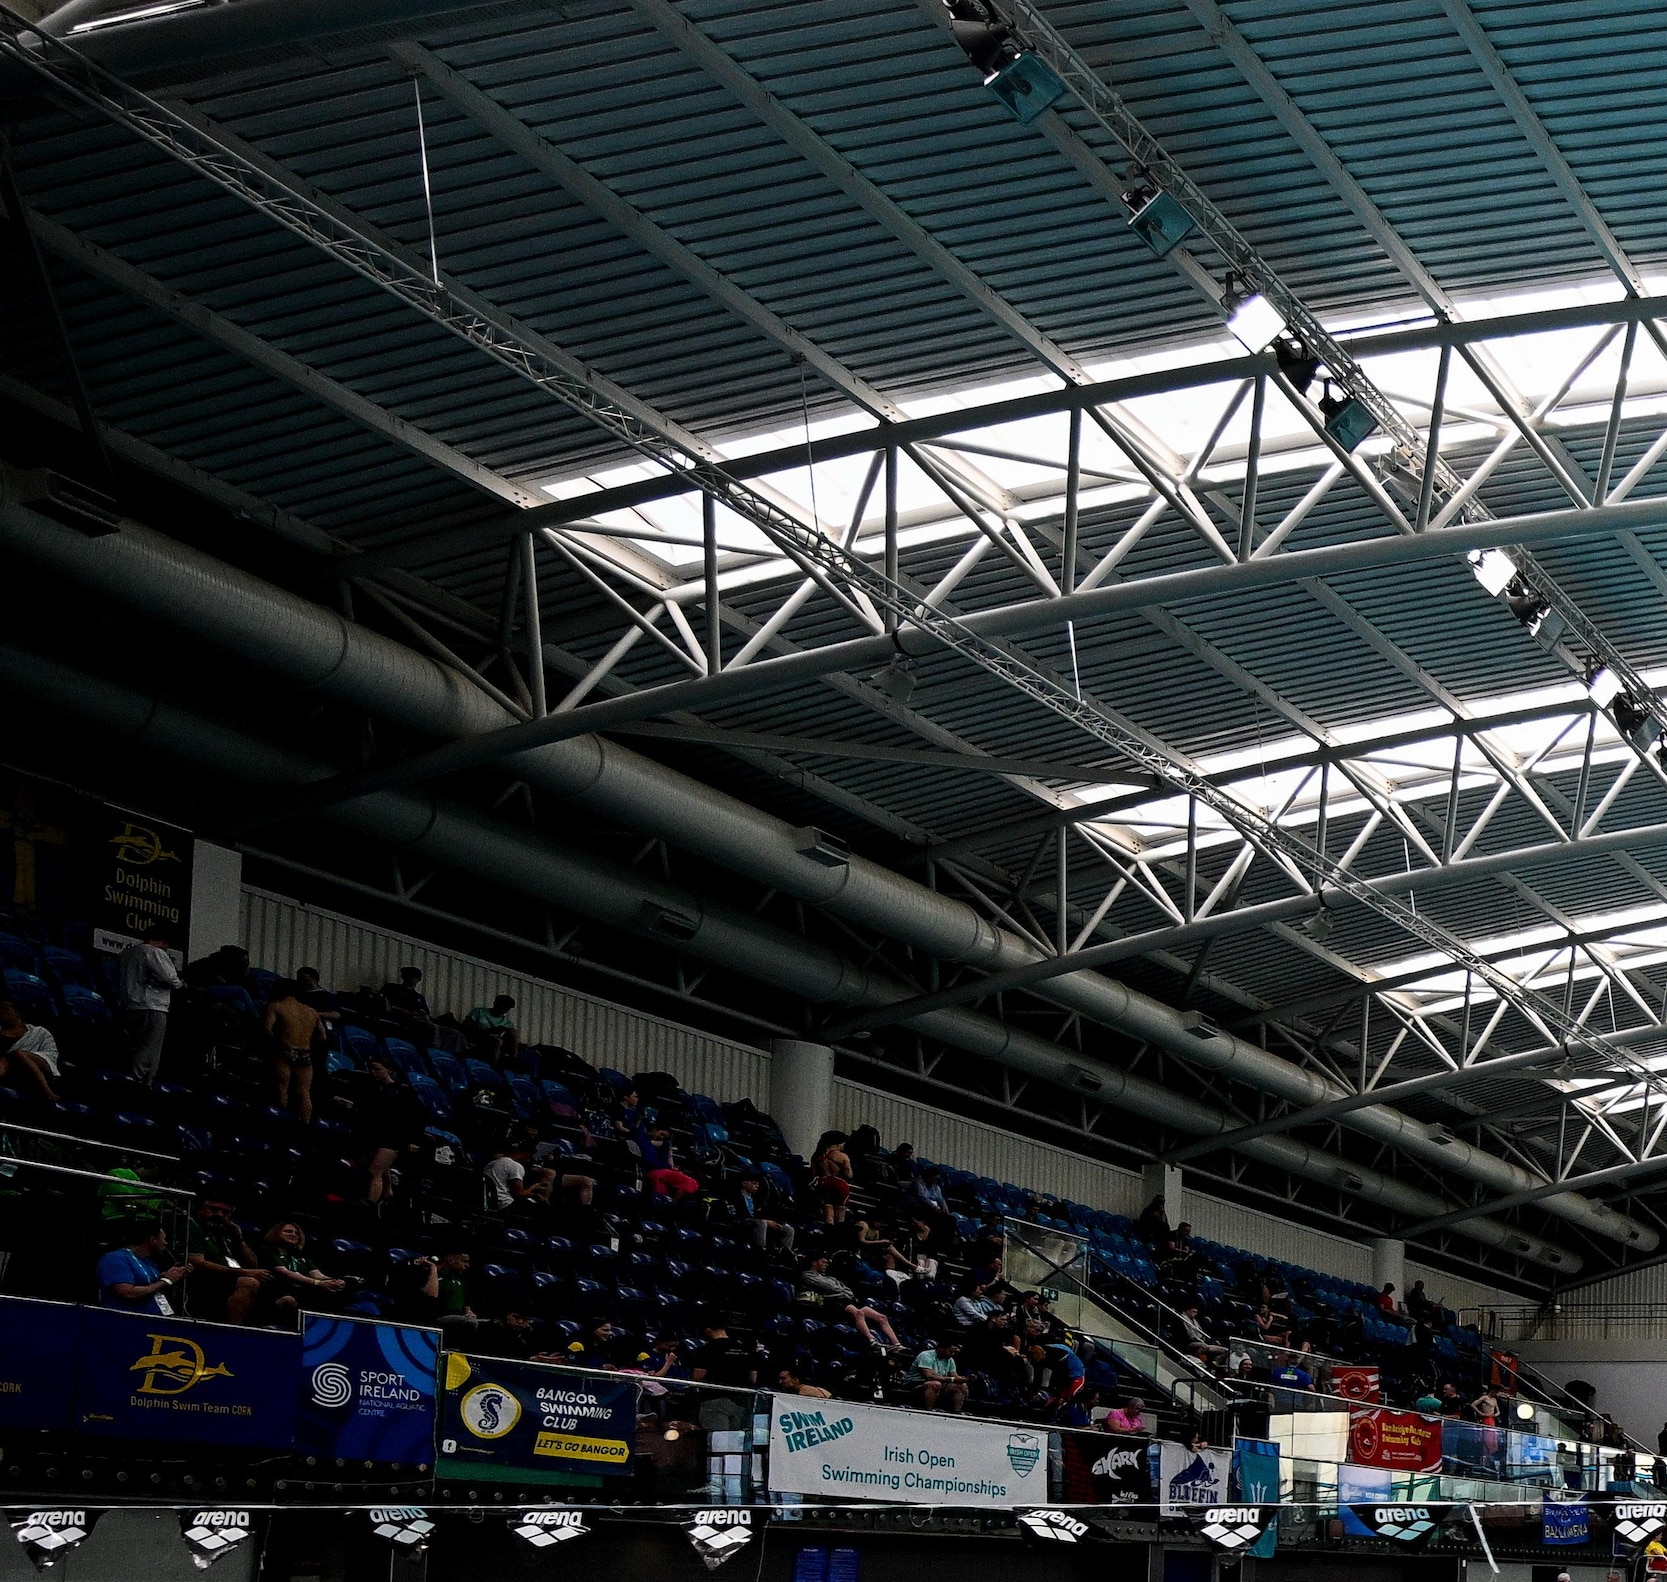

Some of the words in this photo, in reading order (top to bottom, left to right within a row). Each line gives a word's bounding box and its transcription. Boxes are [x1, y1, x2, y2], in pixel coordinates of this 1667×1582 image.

[117, 867, 171, 898] Dolphin
[104, 885, 180, 923] Swimming
[360, 1370, 406, 1387] SPORT
[359, 1384, 421, 1402] IRELAND
[536, 1388, 599, 1405] BANGOR
[130, 1396, 170, 1412] Dolphin
[172, 1398, 200, 1413] Swim
[203, 1401, 230, 1415] Team
[231, 1404, 253, 1417] CORK
[540, 1402, 613, 1420] SWIMMING
[543, 1416, 578, 1430] CLUB
[779, 1410, 826, 1434] SWIM
[785, 1417, 854, 1453] IRELAND
[537, 1438, 563, 1451] LET'S
[564, 1441, 580, 1452] GO
[581, 1443, 626, 1457] BANGOR
[884, 1446, 914, 1464] Irish
[919, 1450, 955, 1469] Open
[1091, 1446, 1143, 1480] SHARK
[822, 1464, 900, 1490] Swimming
[904, 1472, 1007, 1498] Championships
[28, 1510, 85, 1527] arena
[193, 1510, 250, 1527] arena
[369, 1507, 427, 1524] arena
[522, 1511, 583, 1526] arena
[694, 1509, 752, 1525] arena
[1205, 1507, 1260, 1524] arena
[1374, 1506, 1431, 1524] arena
[1615, 1504, 1667, 1520] arena
[1030, 1508, 1089, 1537] arena
